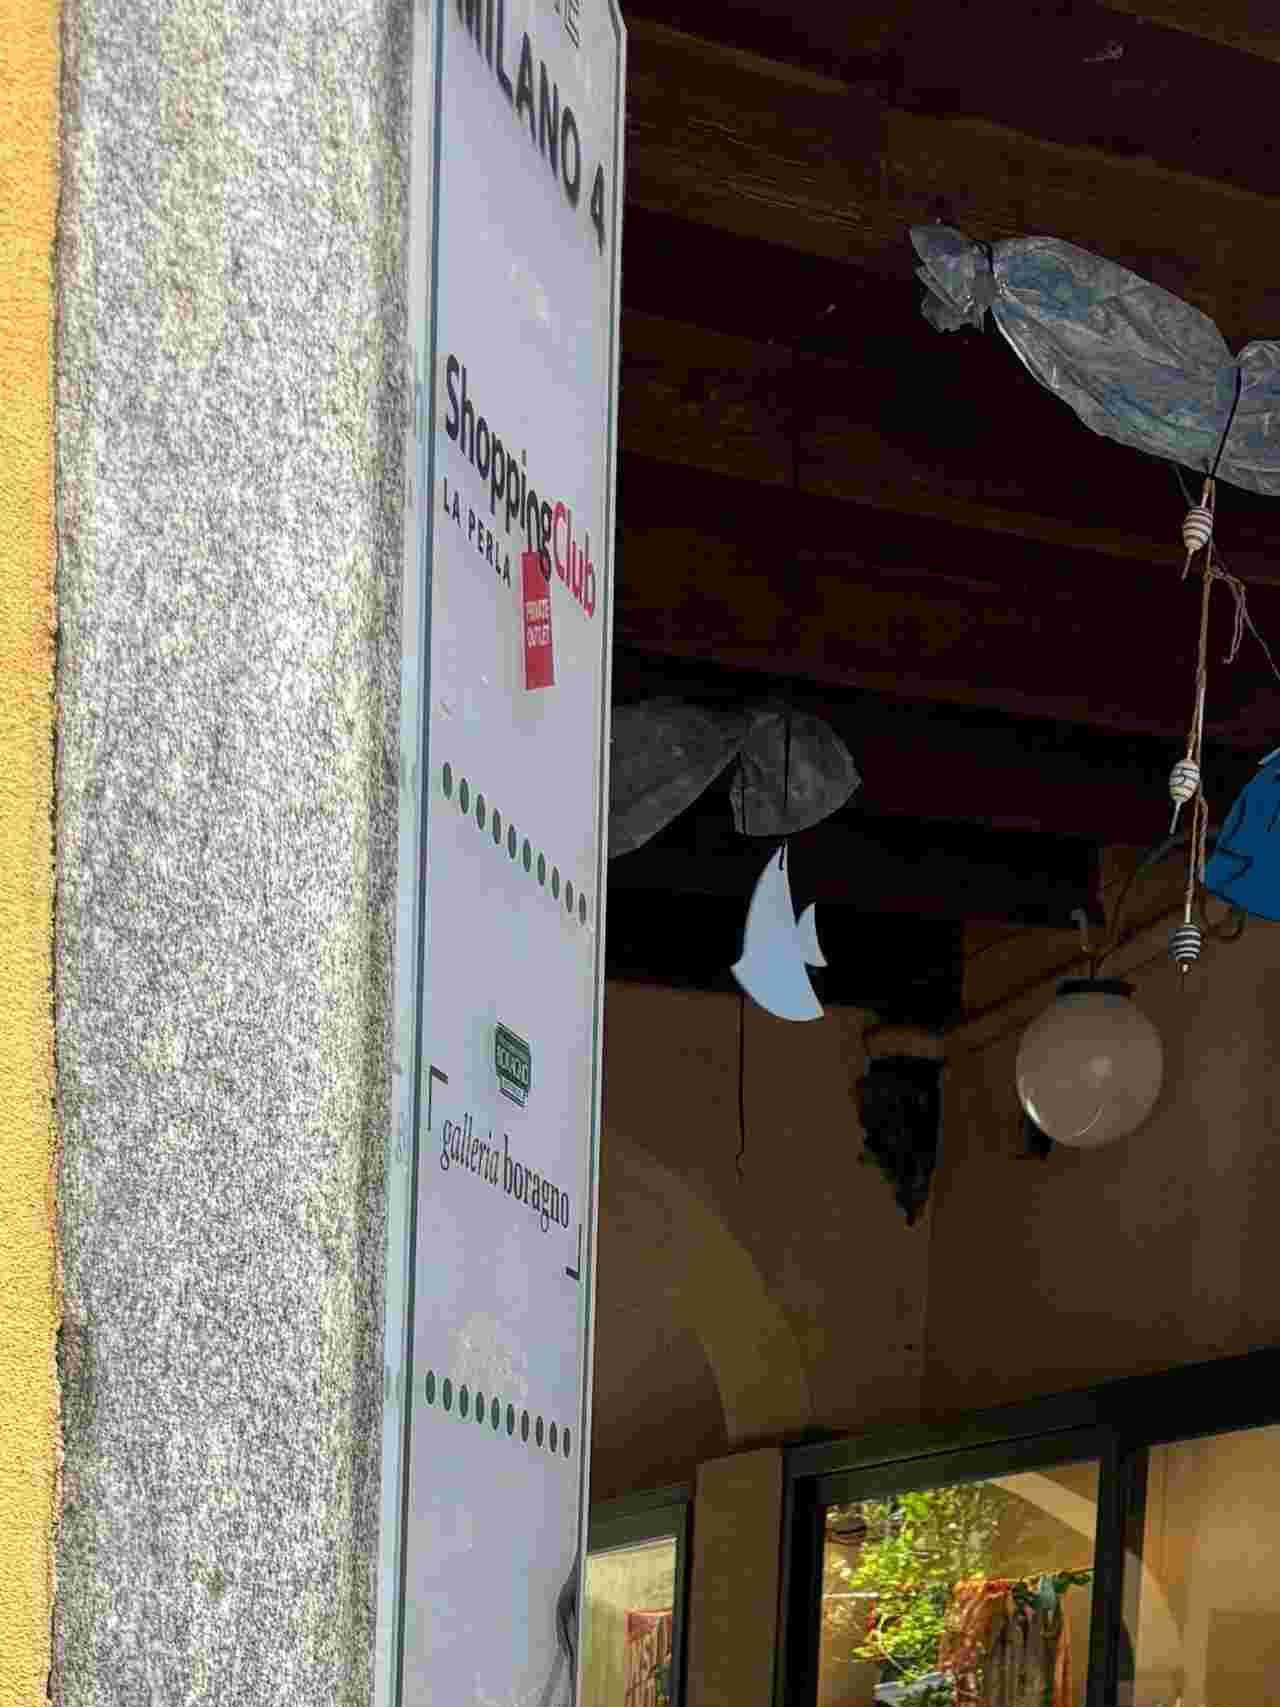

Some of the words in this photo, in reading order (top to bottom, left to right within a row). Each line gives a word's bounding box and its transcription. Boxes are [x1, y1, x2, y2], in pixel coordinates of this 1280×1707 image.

[590, 163, 606, 256] 4
[444, 476, 461, 529] LA
[468, 506, 511, 588] PERLA
[446, 354, 596, 620] ShoppingClub
[440, 1112, 499, 1185] galleria
[504, 1133, 569, 1233] boragno
